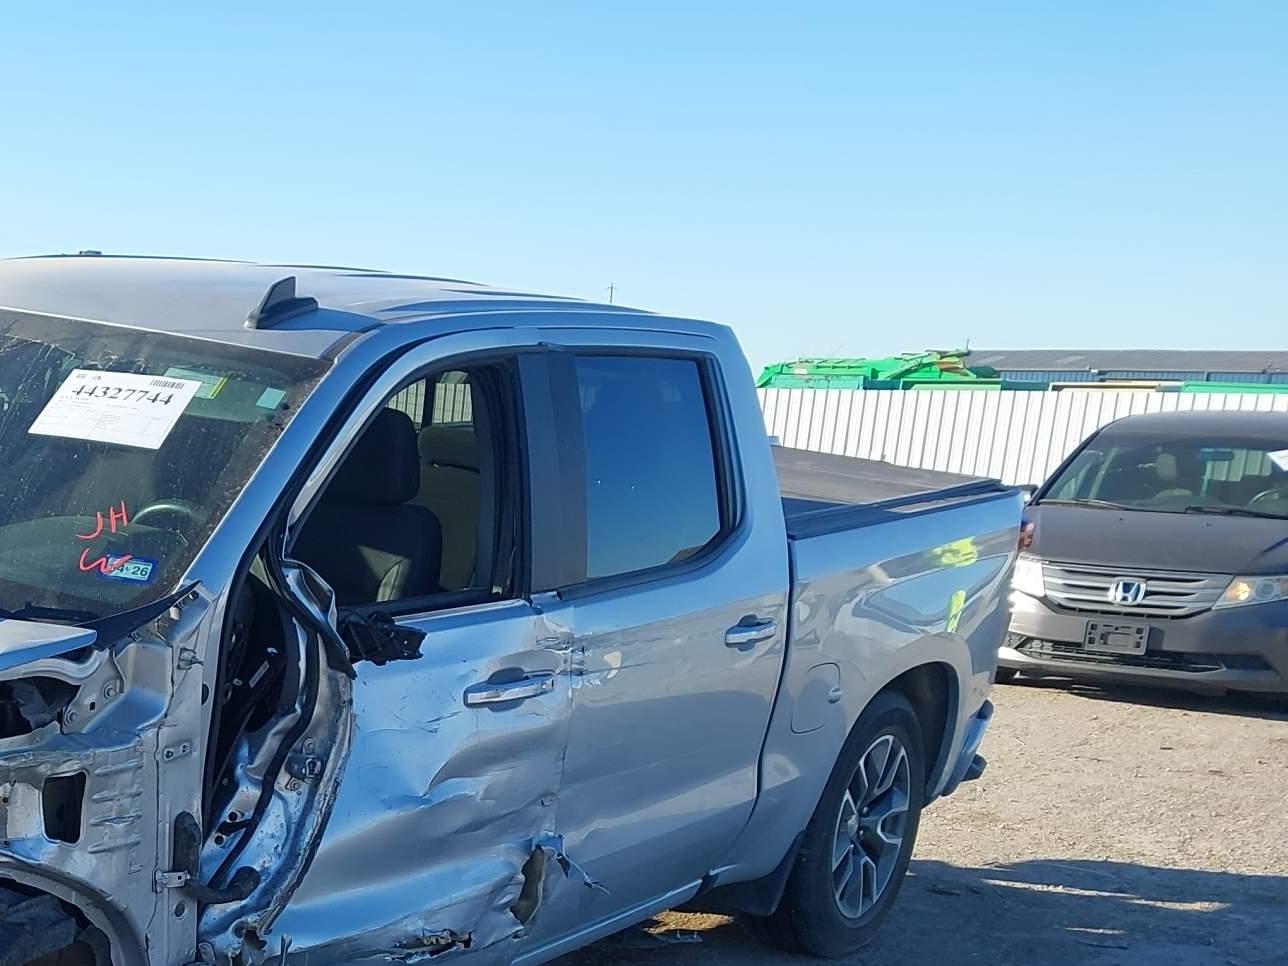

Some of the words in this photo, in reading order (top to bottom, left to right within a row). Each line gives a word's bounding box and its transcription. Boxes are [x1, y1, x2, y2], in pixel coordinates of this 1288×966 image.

[71, 384, 175, 406] 44327744
[75, 500, 129, 541] JH
[130, 565, 150, 577] 26
